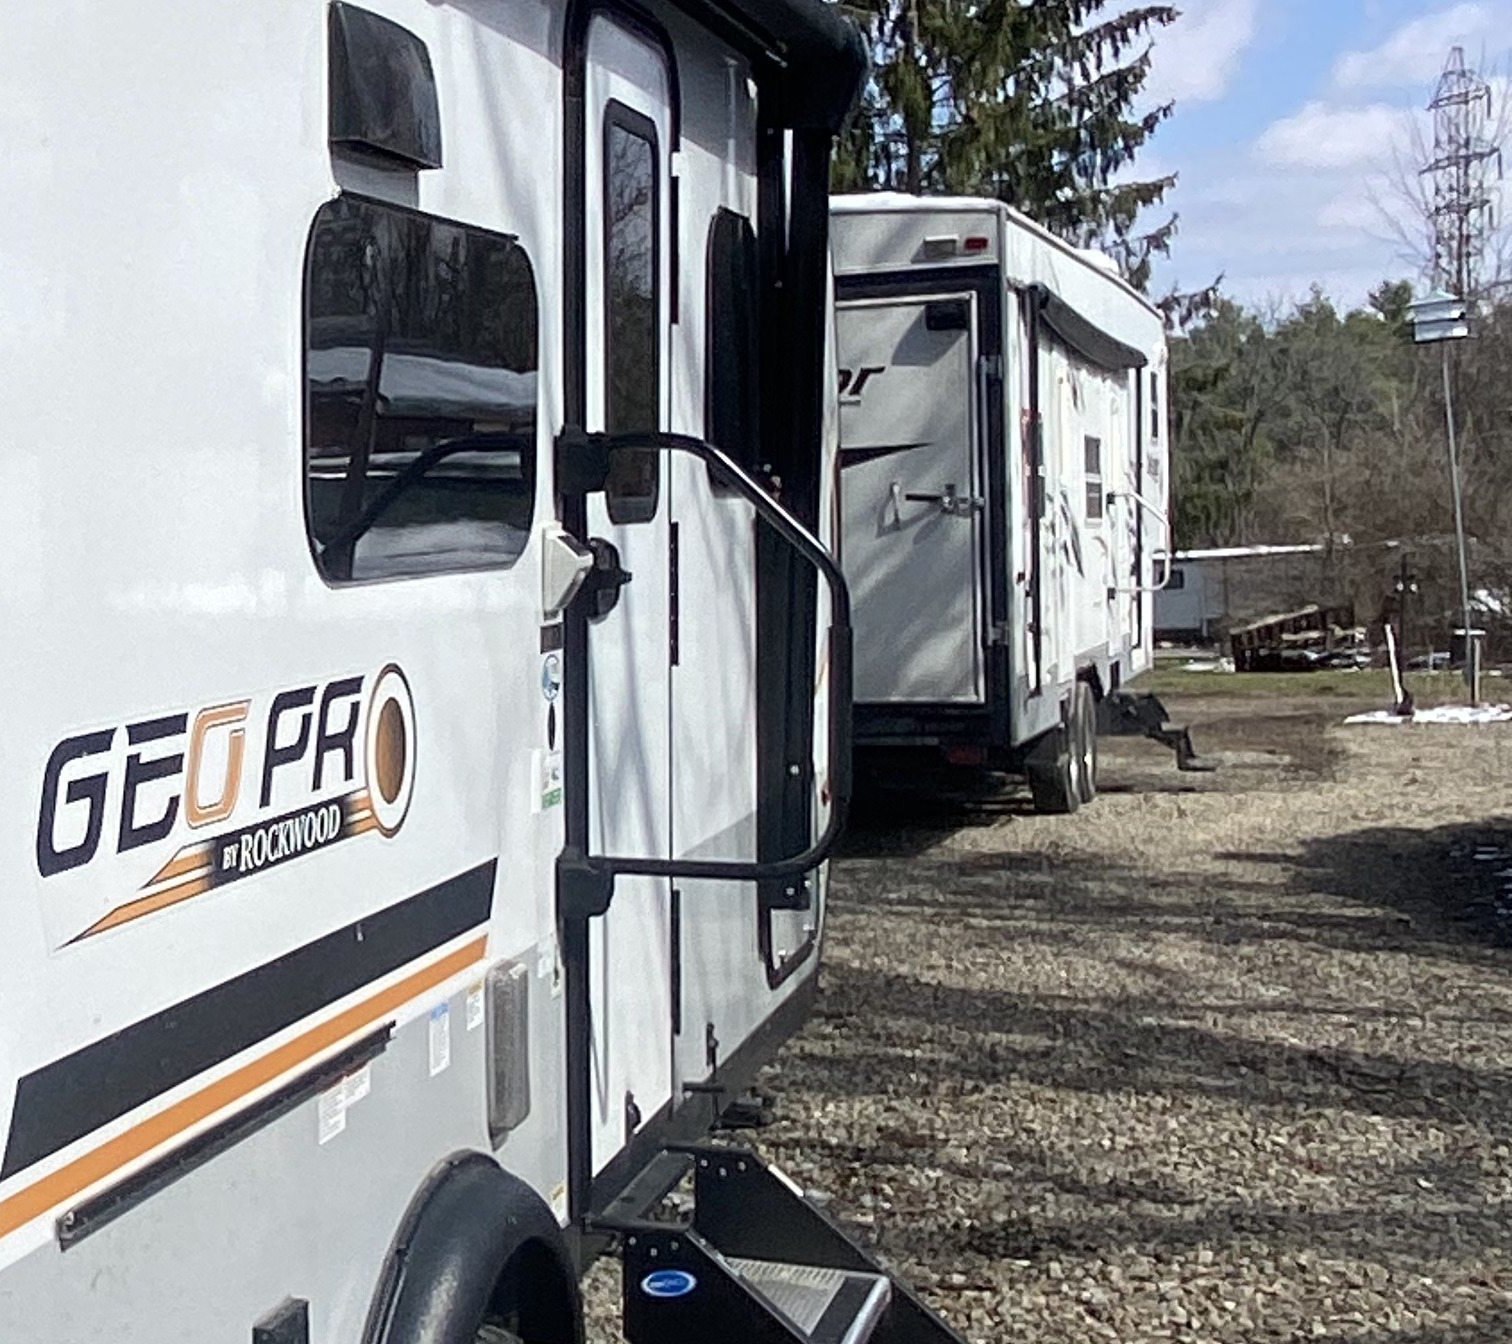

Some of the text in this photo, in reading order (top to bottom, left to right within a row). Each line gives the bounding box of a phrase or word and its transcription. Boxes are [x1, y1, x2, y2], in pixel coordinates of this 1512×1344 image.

[37, 699, 252, 878] GEO
[223, 804, 341, 872] BY ROCKWOOD
